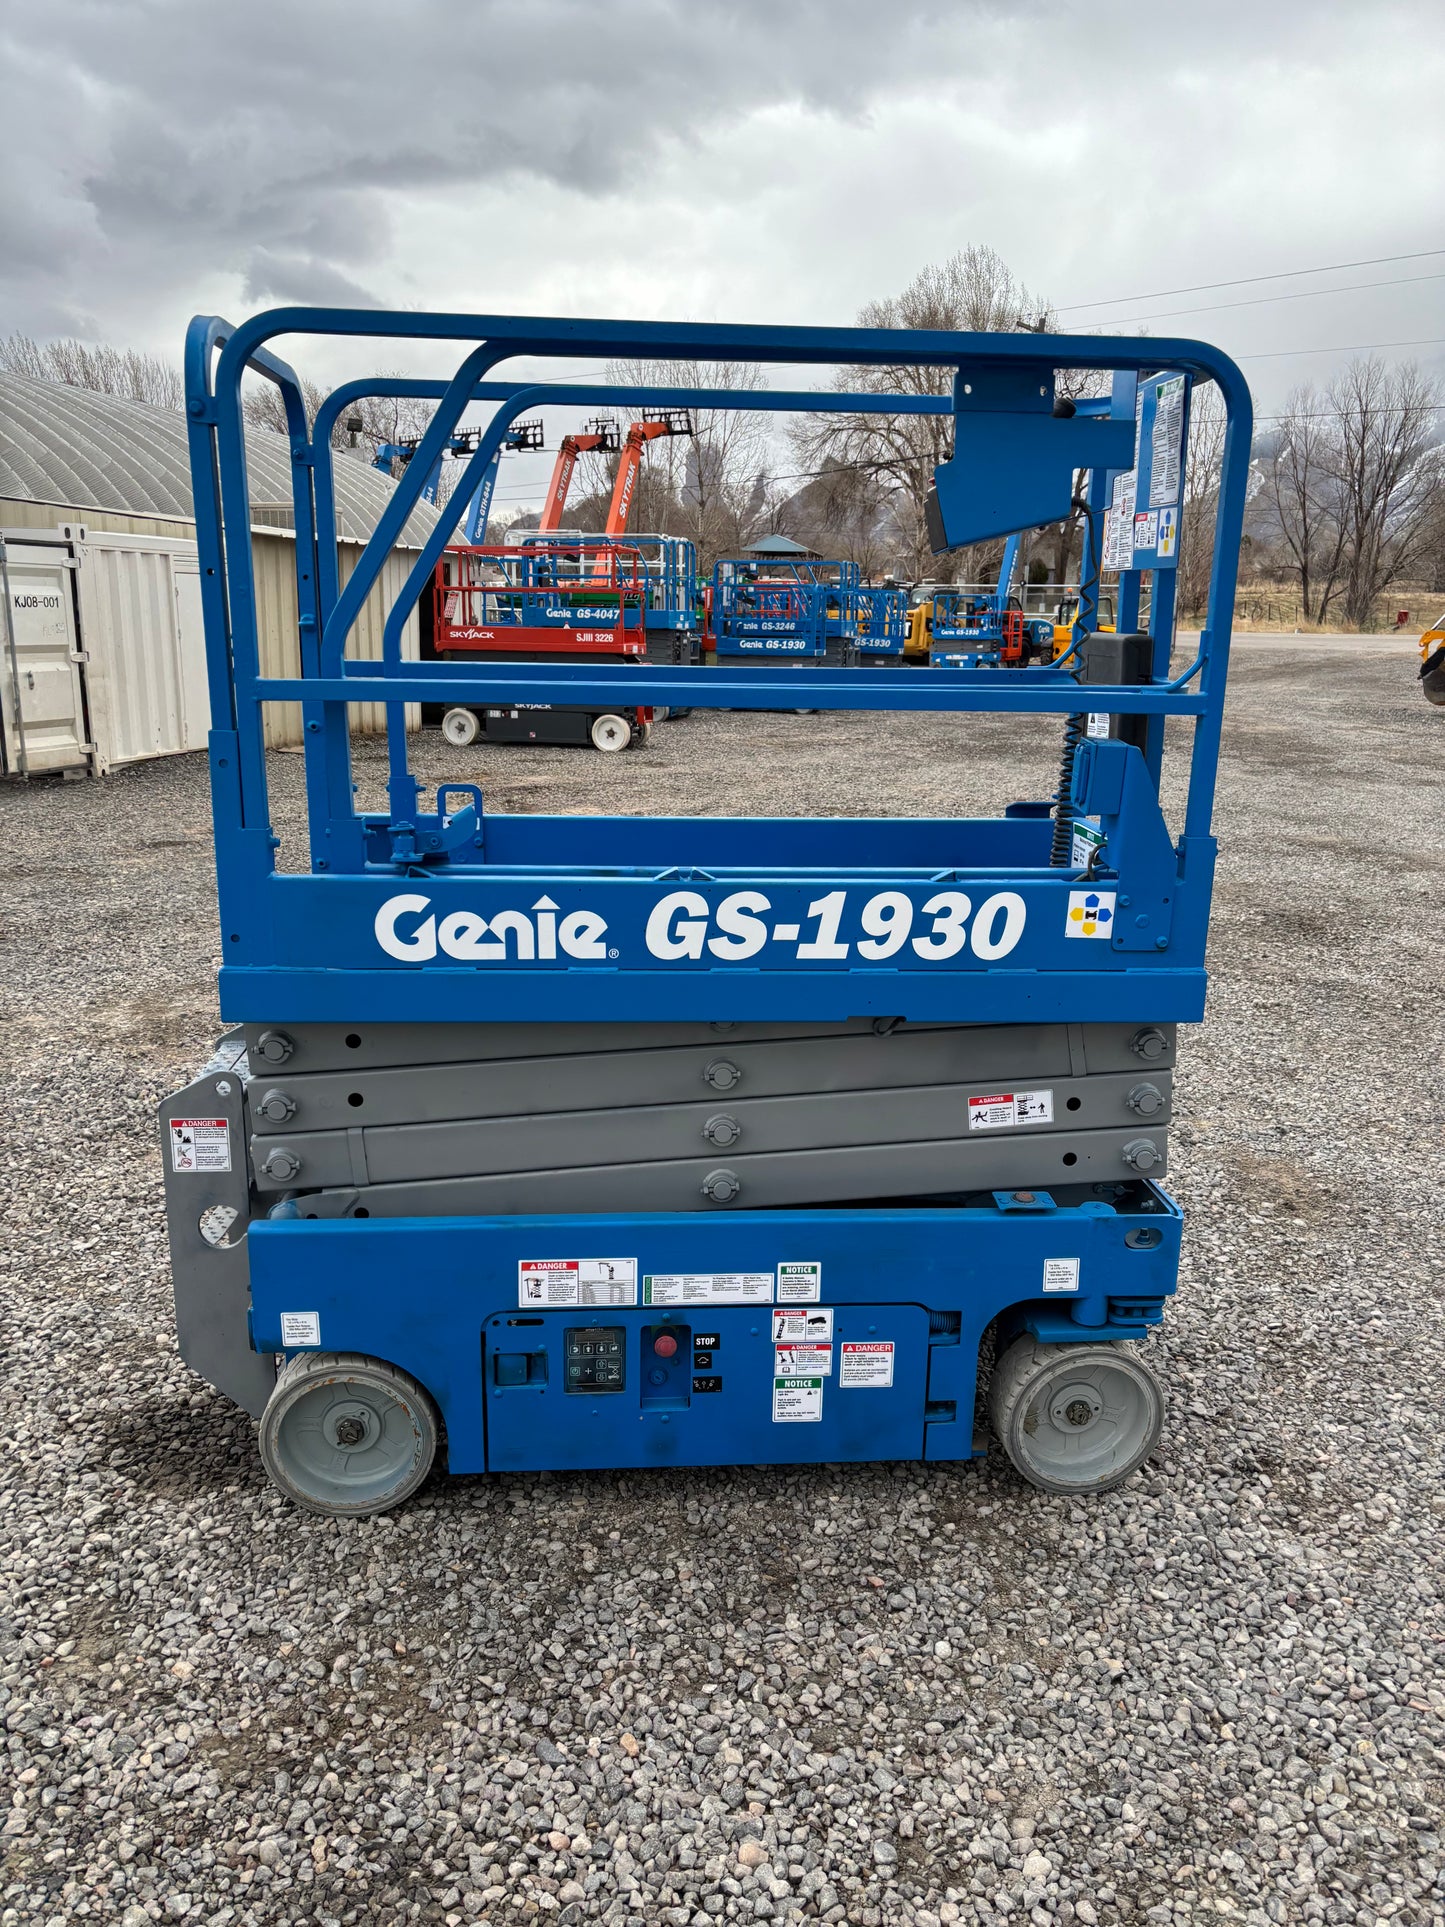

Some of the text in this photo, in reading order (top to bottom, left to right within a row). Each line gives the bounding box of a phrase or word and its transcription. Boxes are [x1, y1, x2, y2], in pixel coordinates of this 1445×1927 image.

[557, 459, 572, 501] SKYTRAK
[619, 461, 636, 519] SKYTRAK
[14, 595, 59, 608] KJ08-001
[546, 608, 621, 620] Genie GS-4047
[761, 622, 796, 631] GS-3246
[449, 628, 495, 640] SKYJACK
[576, 633, 614, 643] SJIII 3226
[740, 639, 806, 650] Genie GS-1930
[854, 638, 891, 648] GS-1930
[645, 890, 1027, 961] GS-1930
[537, 1262, 568, 1270] DANGER
[786, 1266, 812, 1274] NOTICE
[695, 1337, 716, 1346] STOP
[855, 1344, 892, 1352] DANGER
[785, 1380, 813, 1388] NOTICE
